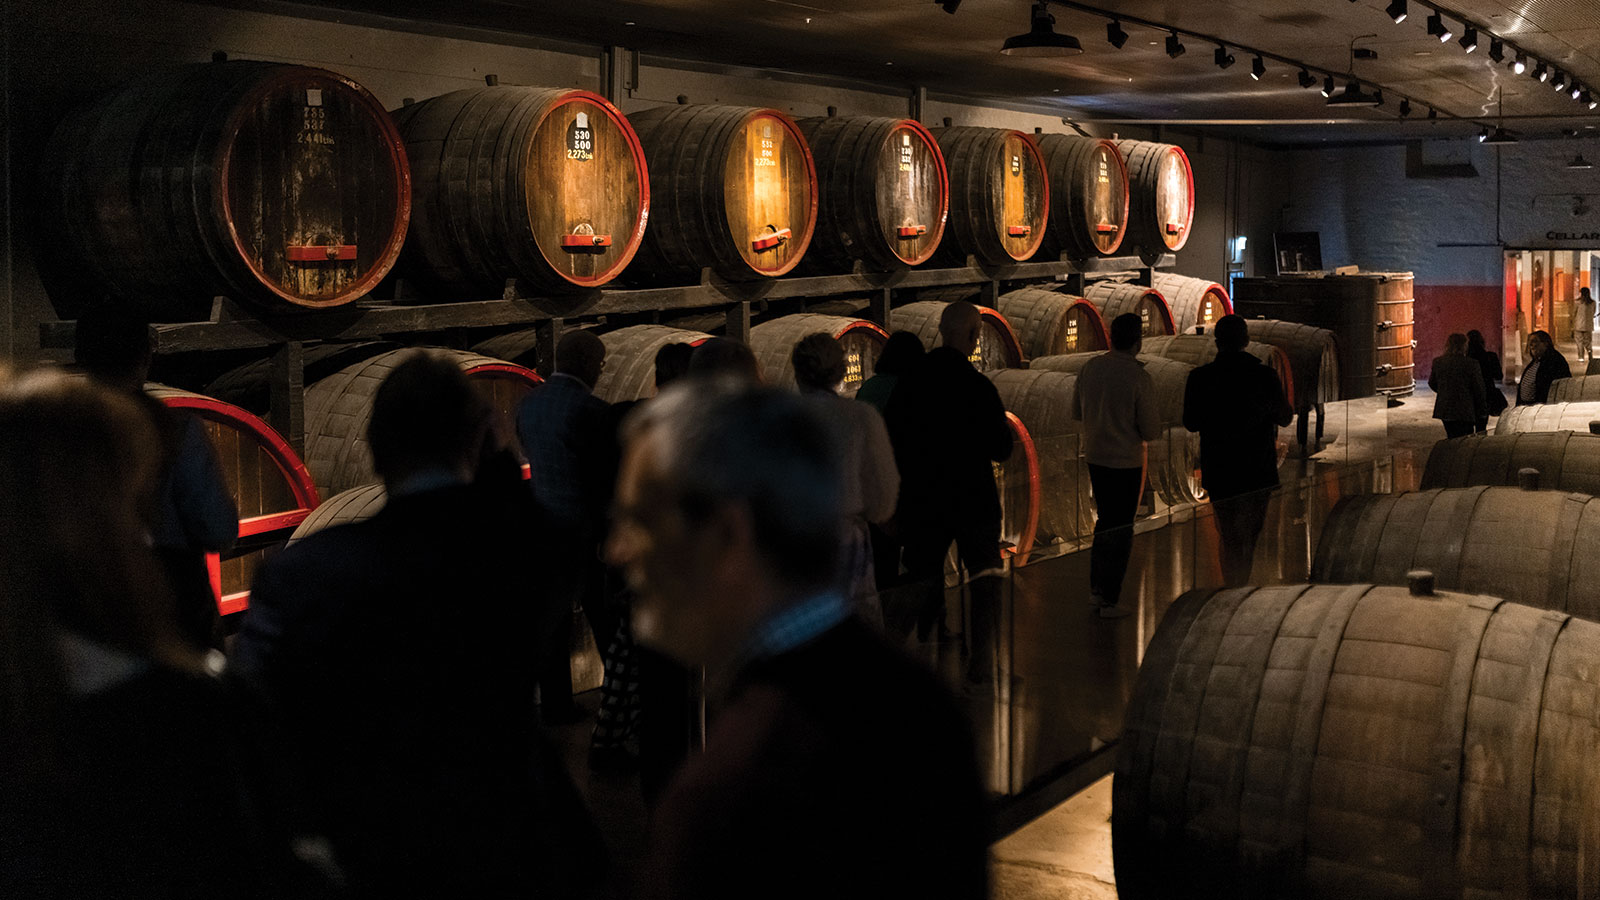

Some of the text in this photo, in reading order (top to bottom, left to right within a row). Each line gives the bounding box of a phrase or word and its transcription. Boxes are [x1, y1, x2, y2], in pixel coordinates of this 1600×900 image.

[574, 130, 590, 140] 530
[574, 140, 591, 150] 500
[1546, 231, 1600, 240] CELLAR
